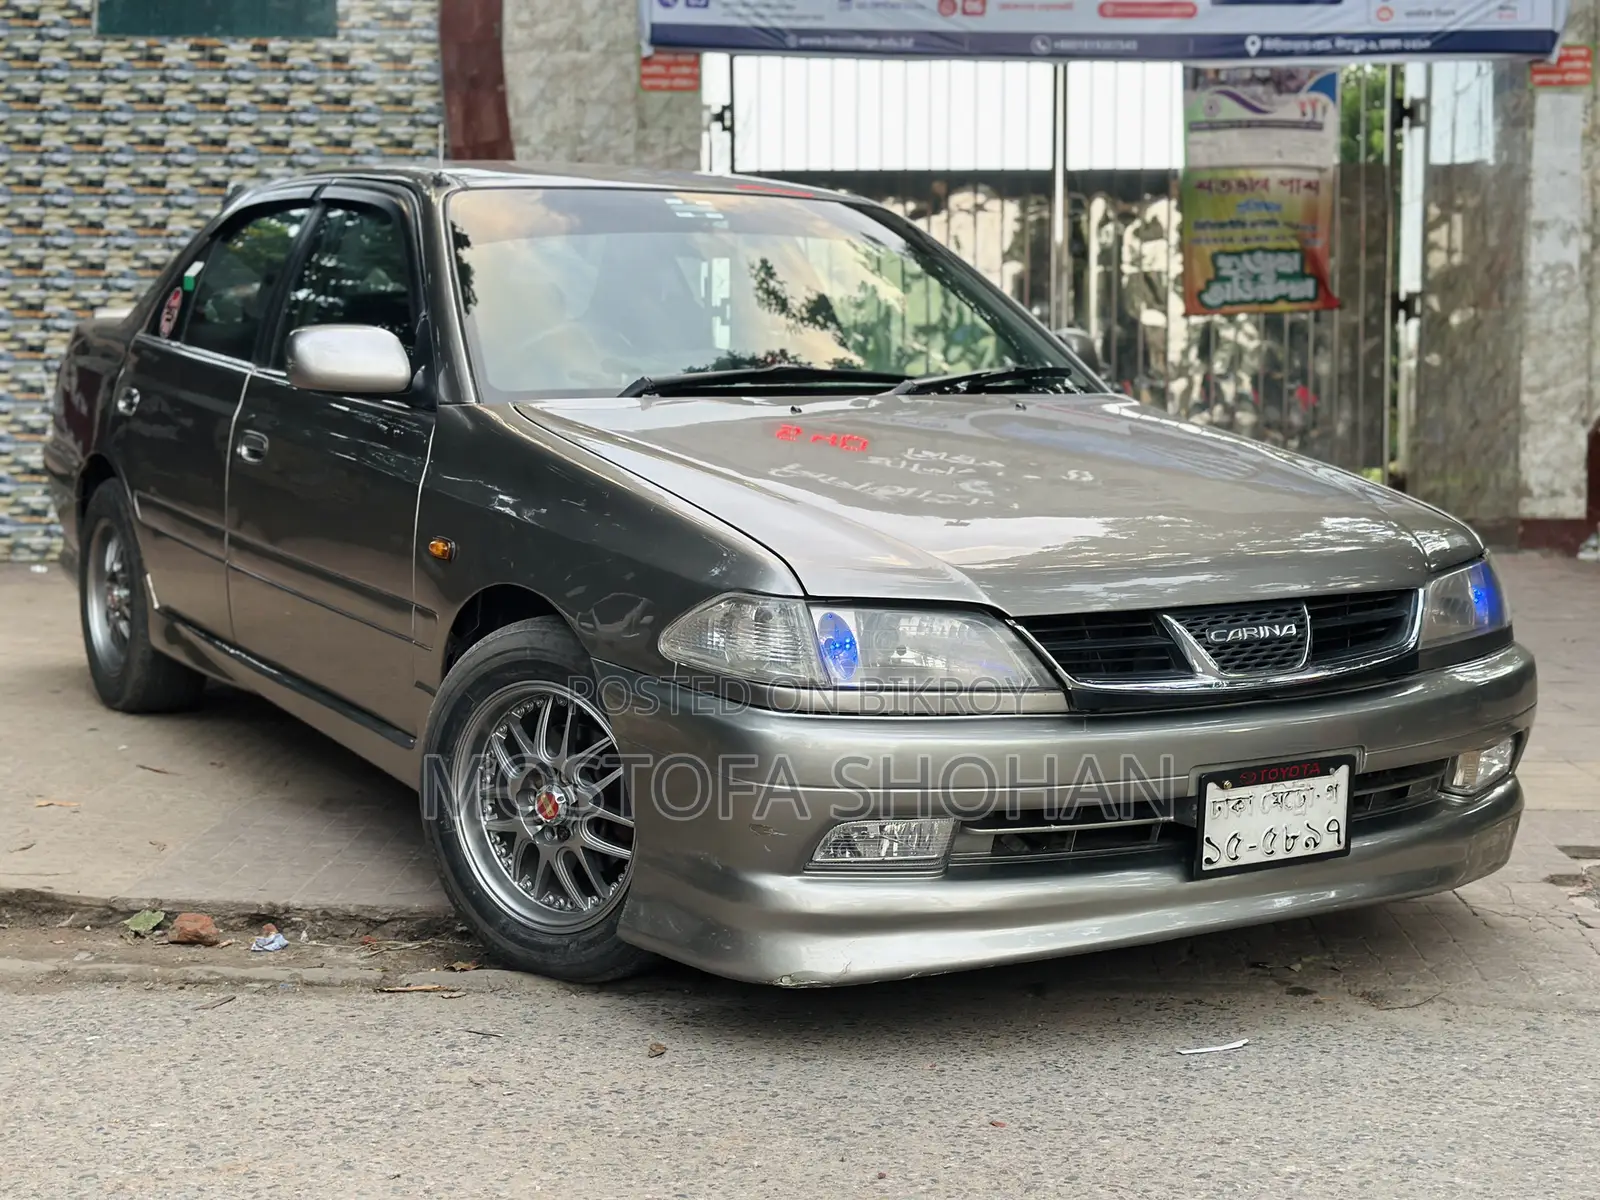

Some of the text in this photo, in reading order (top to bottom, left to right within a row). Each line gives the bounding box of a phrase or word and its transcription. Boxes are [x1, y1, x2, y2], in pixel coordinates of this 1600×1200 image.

[1209, 623, 1297, 642] CARINA
[1259, 762, 1320, 782] TOYOTA
[1209, 795, 1254, 820] ঢাকা
[1203, 817, 1343, 865] ১৫-৫৮৯৭
